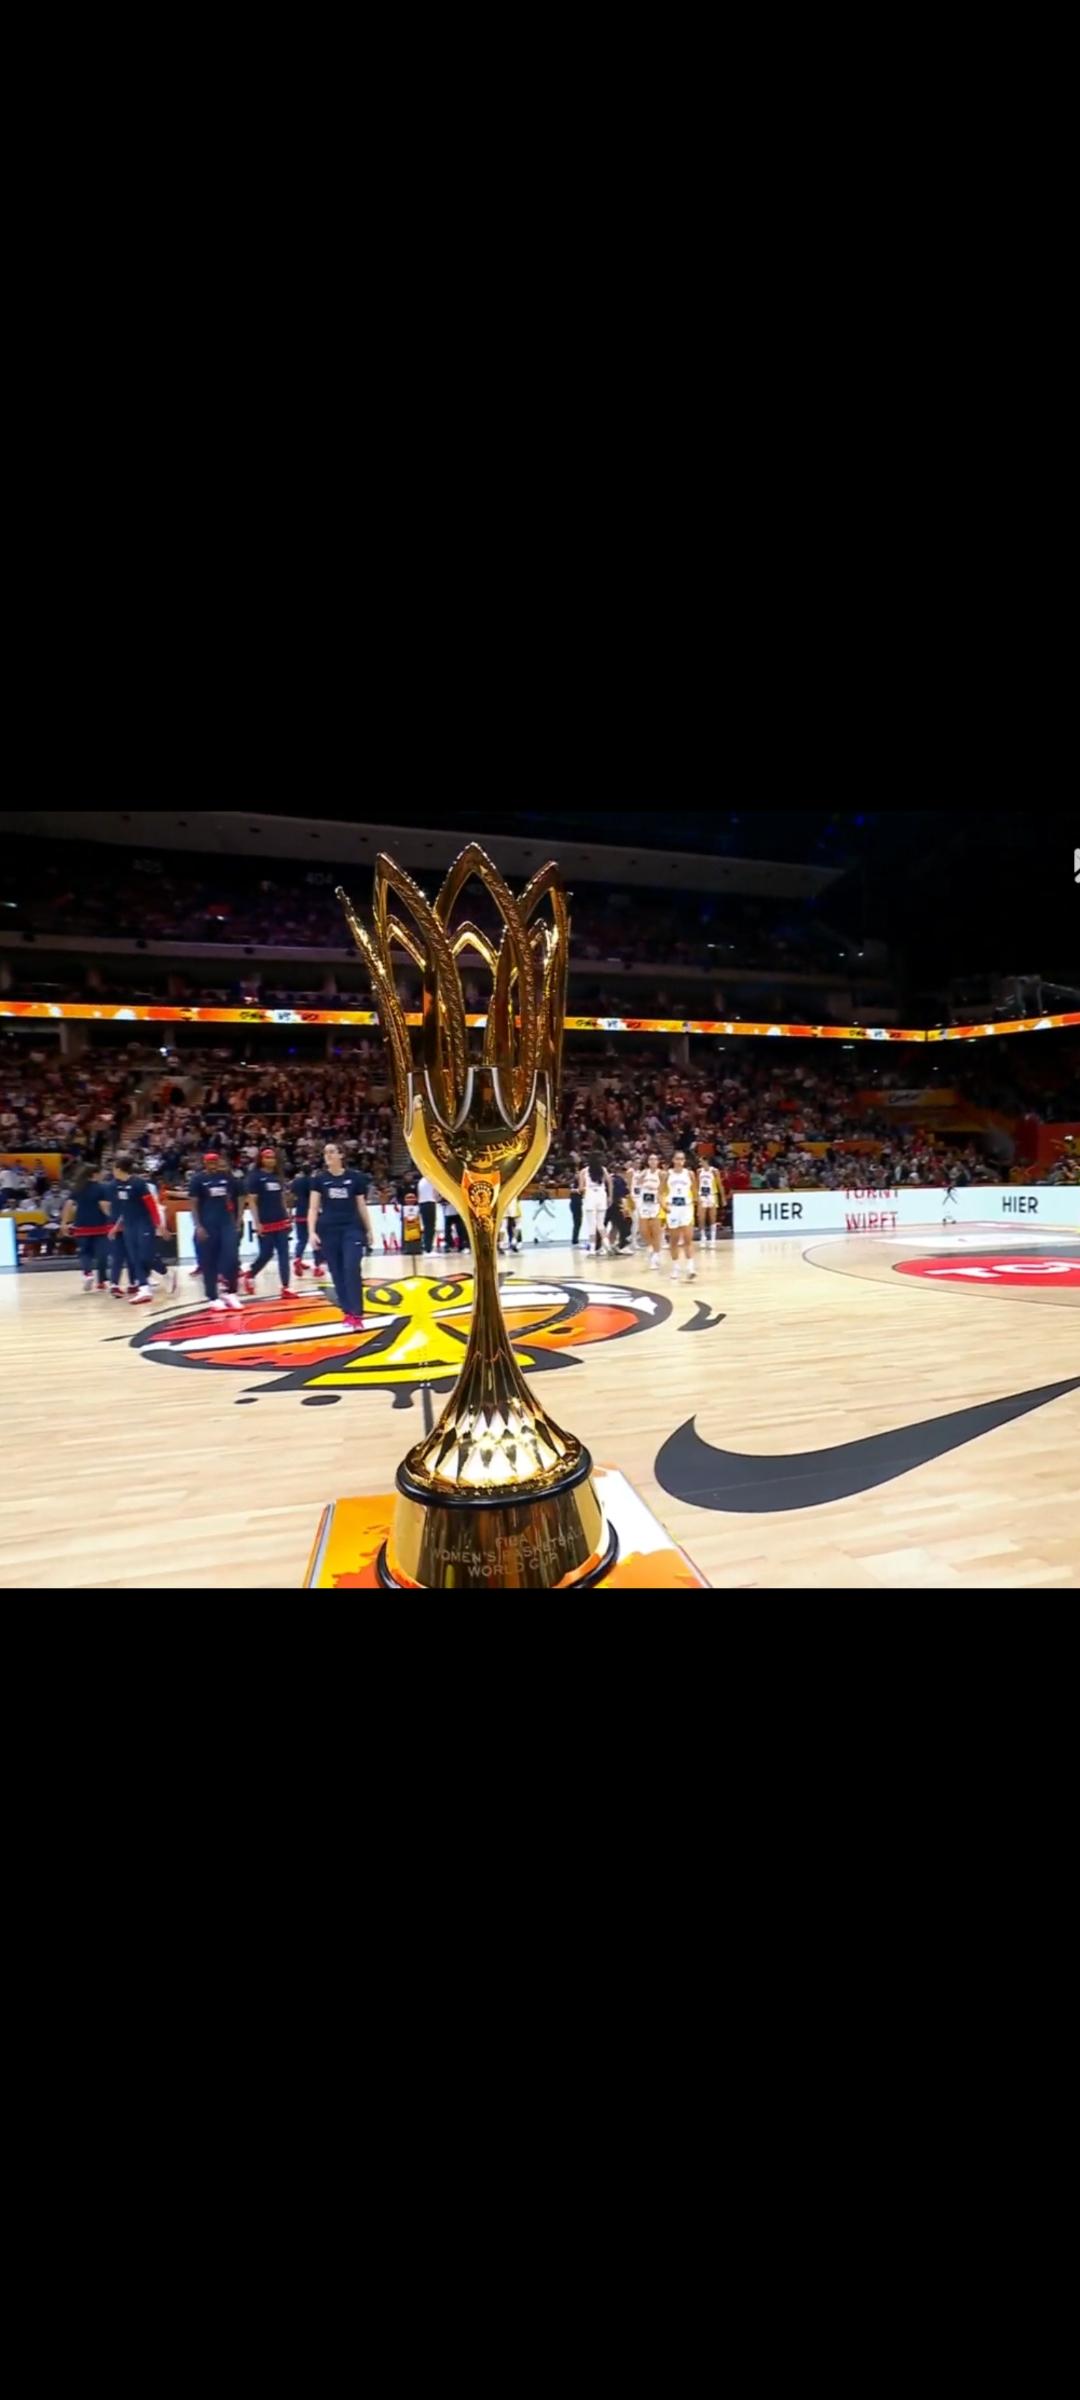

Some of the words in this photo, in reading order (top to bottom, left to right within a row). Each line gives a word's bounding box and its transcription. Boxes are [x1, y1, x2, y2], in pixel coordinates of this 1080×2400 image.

[760, 1202, 803, 1221] HIER
[1002, 1196, 1038, 1214] HIER
[496, 1533, 528, 1548] FIBA
[467, 1562, 524, 1578] WORLD
[529, 1552, 559, 1570] CUP
